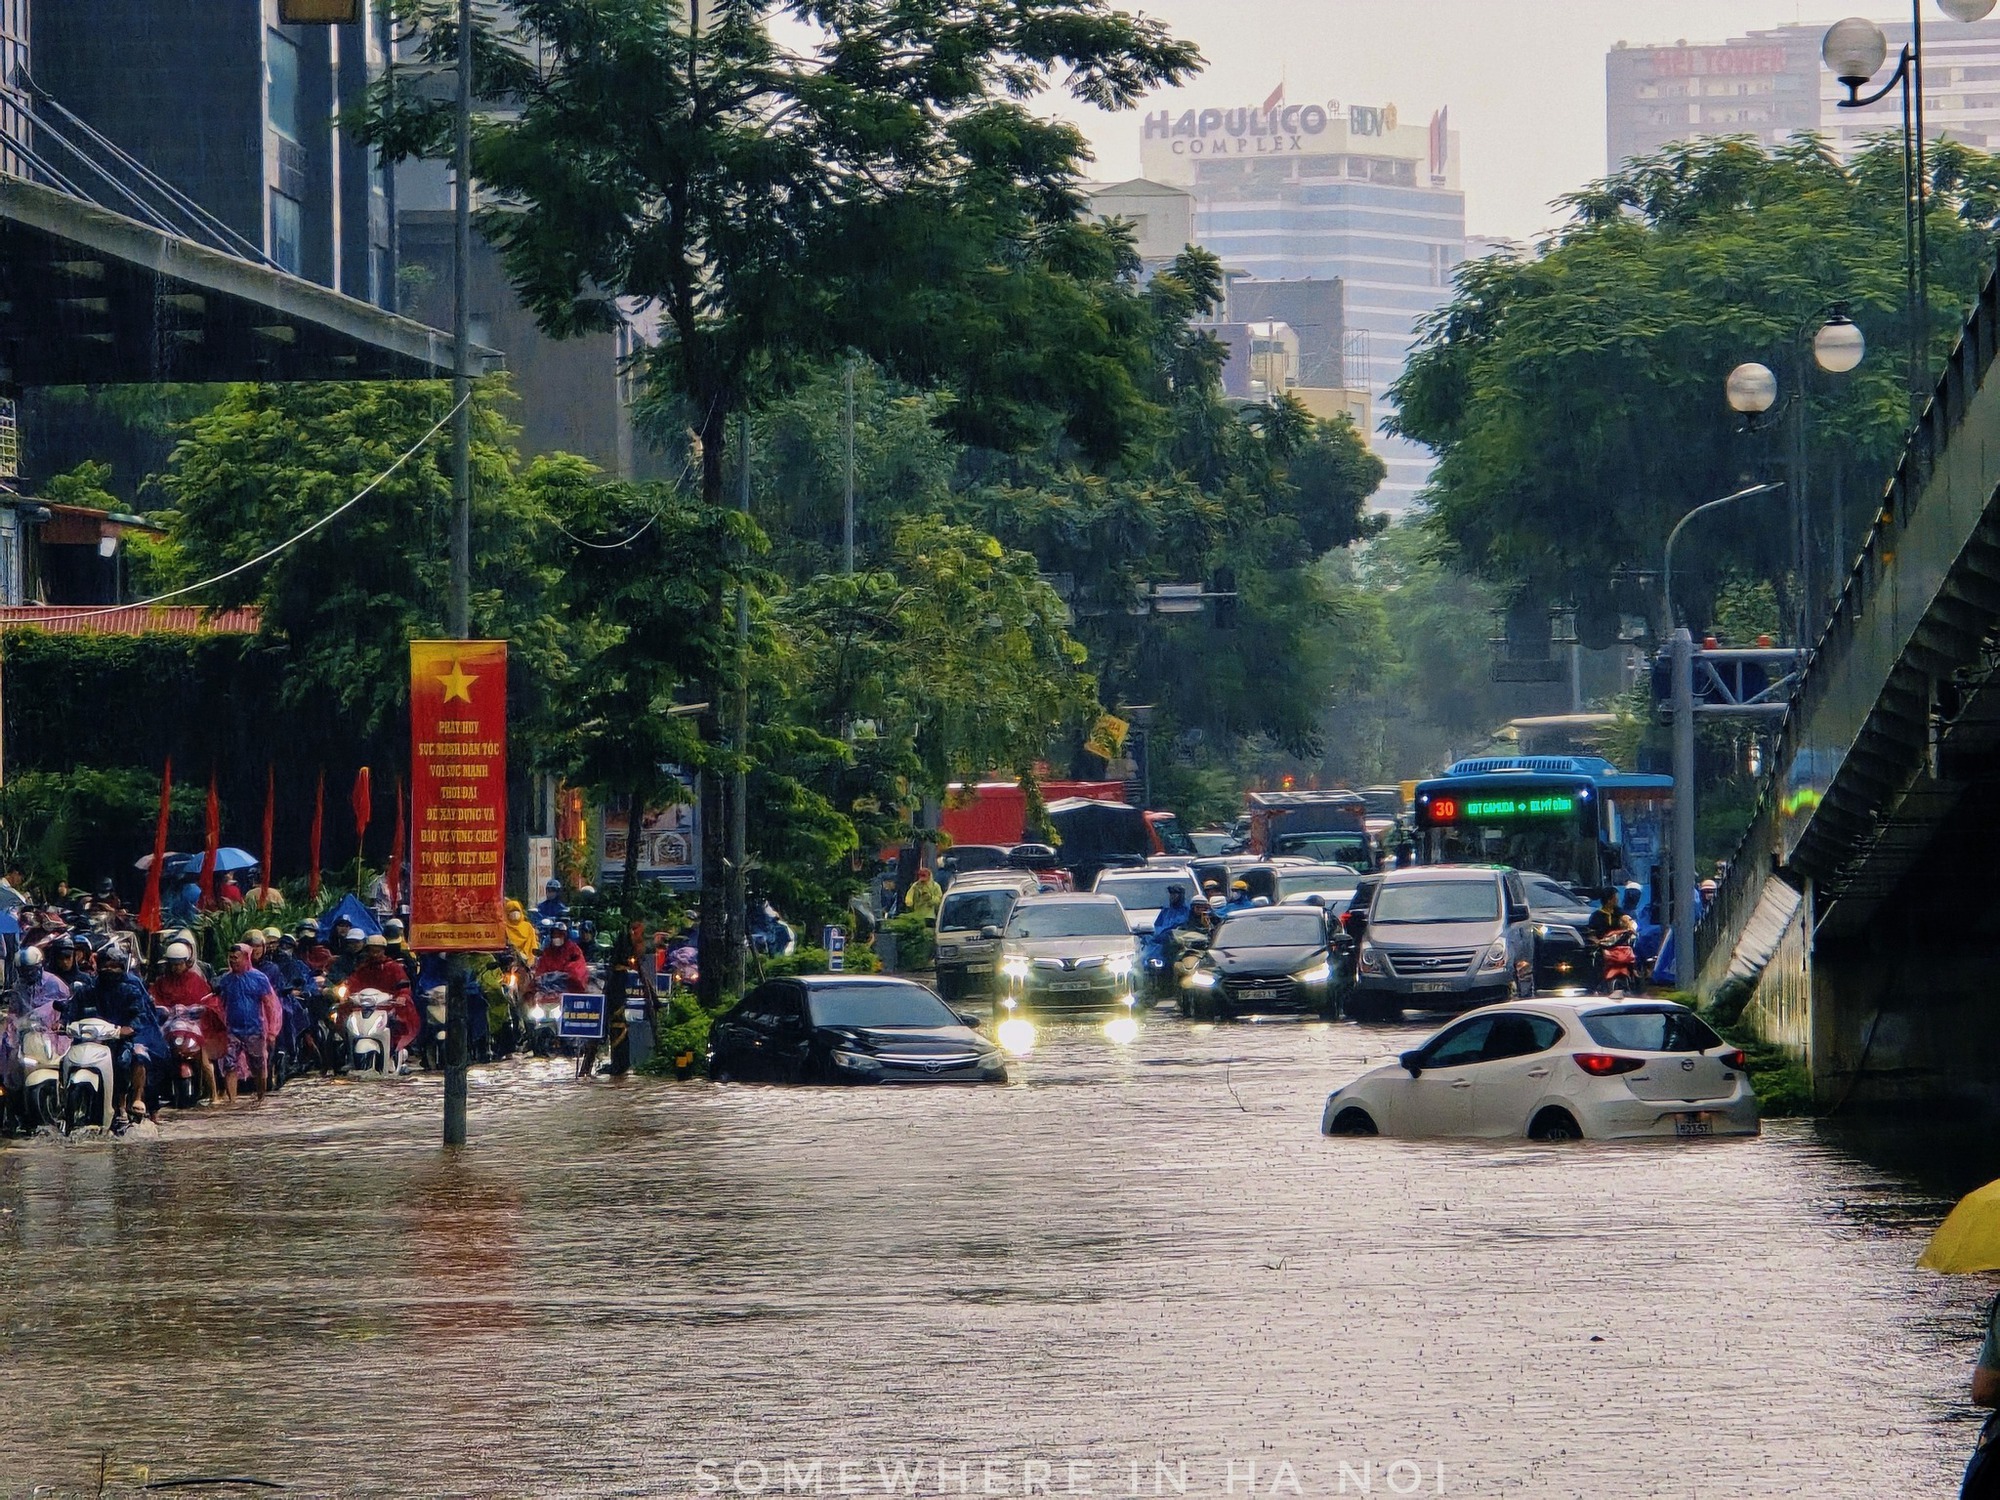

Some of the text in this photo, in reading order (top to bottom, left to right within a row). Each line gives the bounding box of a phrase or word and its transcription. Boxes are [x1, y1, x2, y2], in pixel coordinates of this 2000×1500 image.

[1144, 104, 1327, 139] HAPULICO
[1172, 135, 1302, 154] COMPLEX
[1435, 802, 1454, 817] 30
